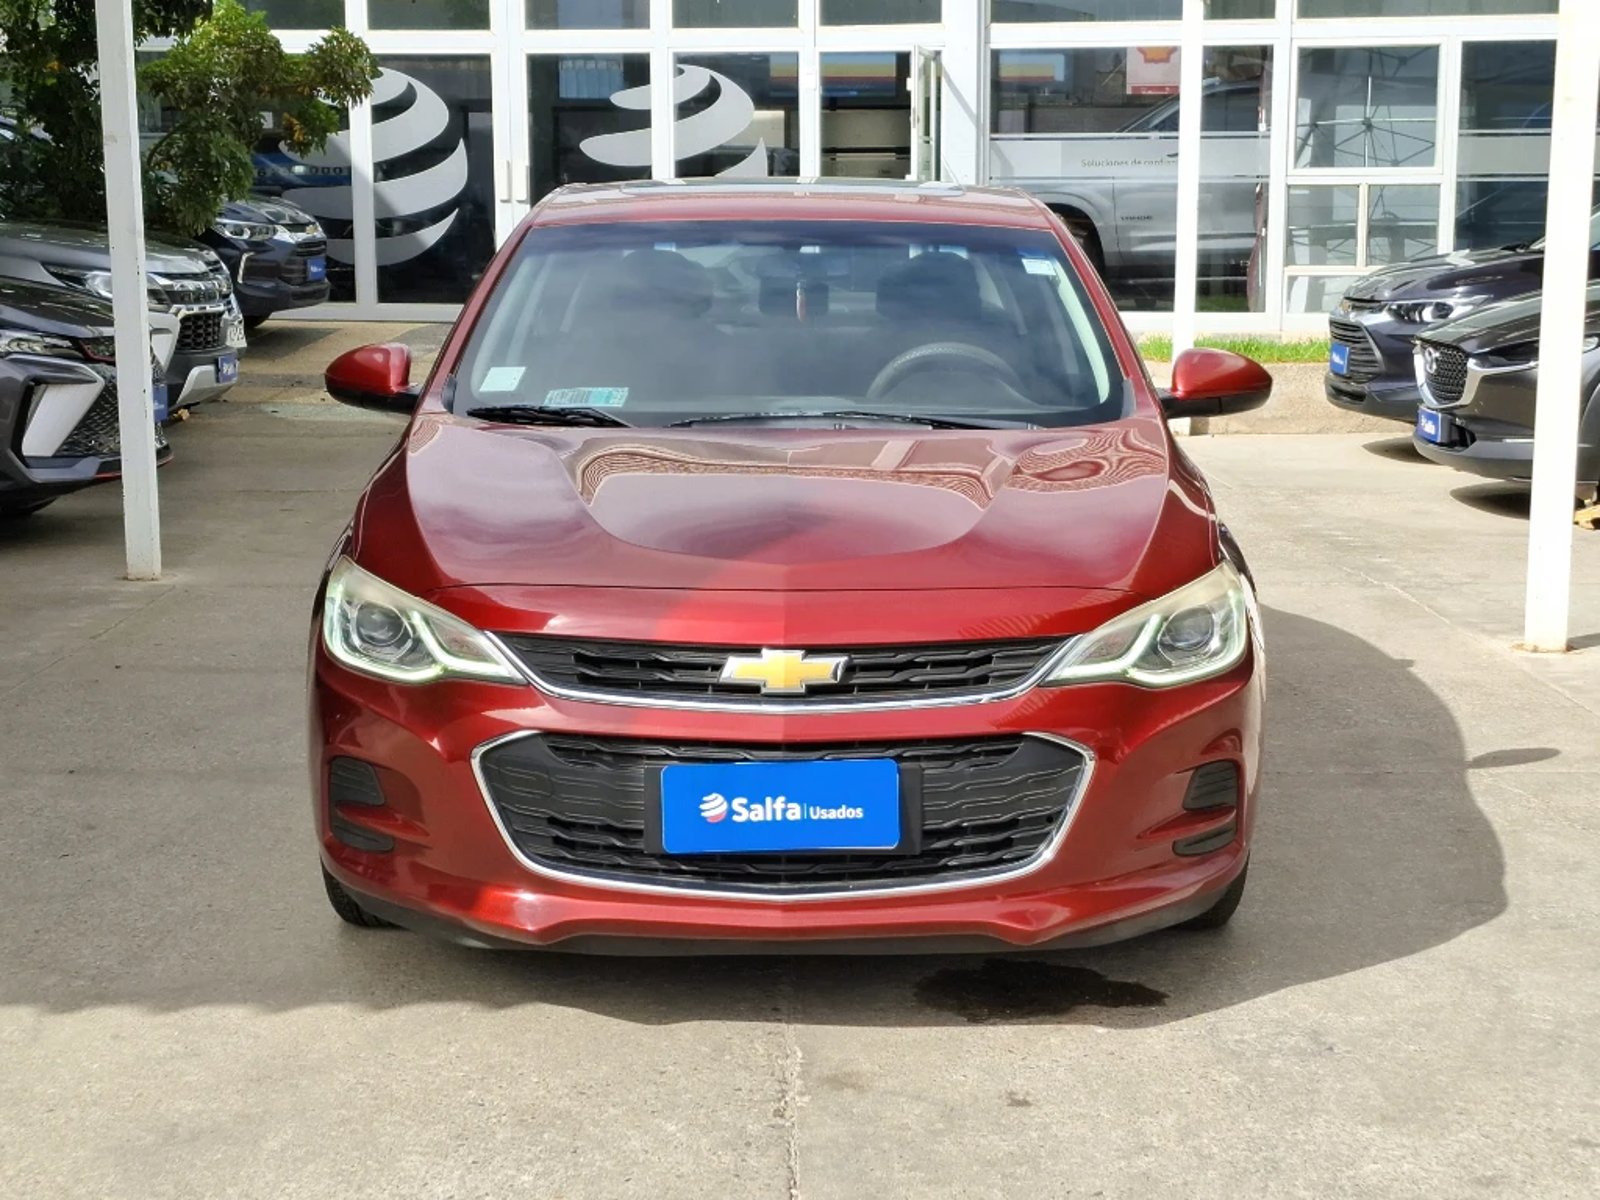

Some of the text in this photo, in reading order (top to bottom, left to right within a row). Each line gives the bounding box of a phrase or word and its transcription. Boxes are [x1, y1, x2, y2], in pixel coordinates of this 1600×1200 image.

[1081, 158, 1128, 168] Soluciones
[731, 795, 864, 822] Salfa Usados
